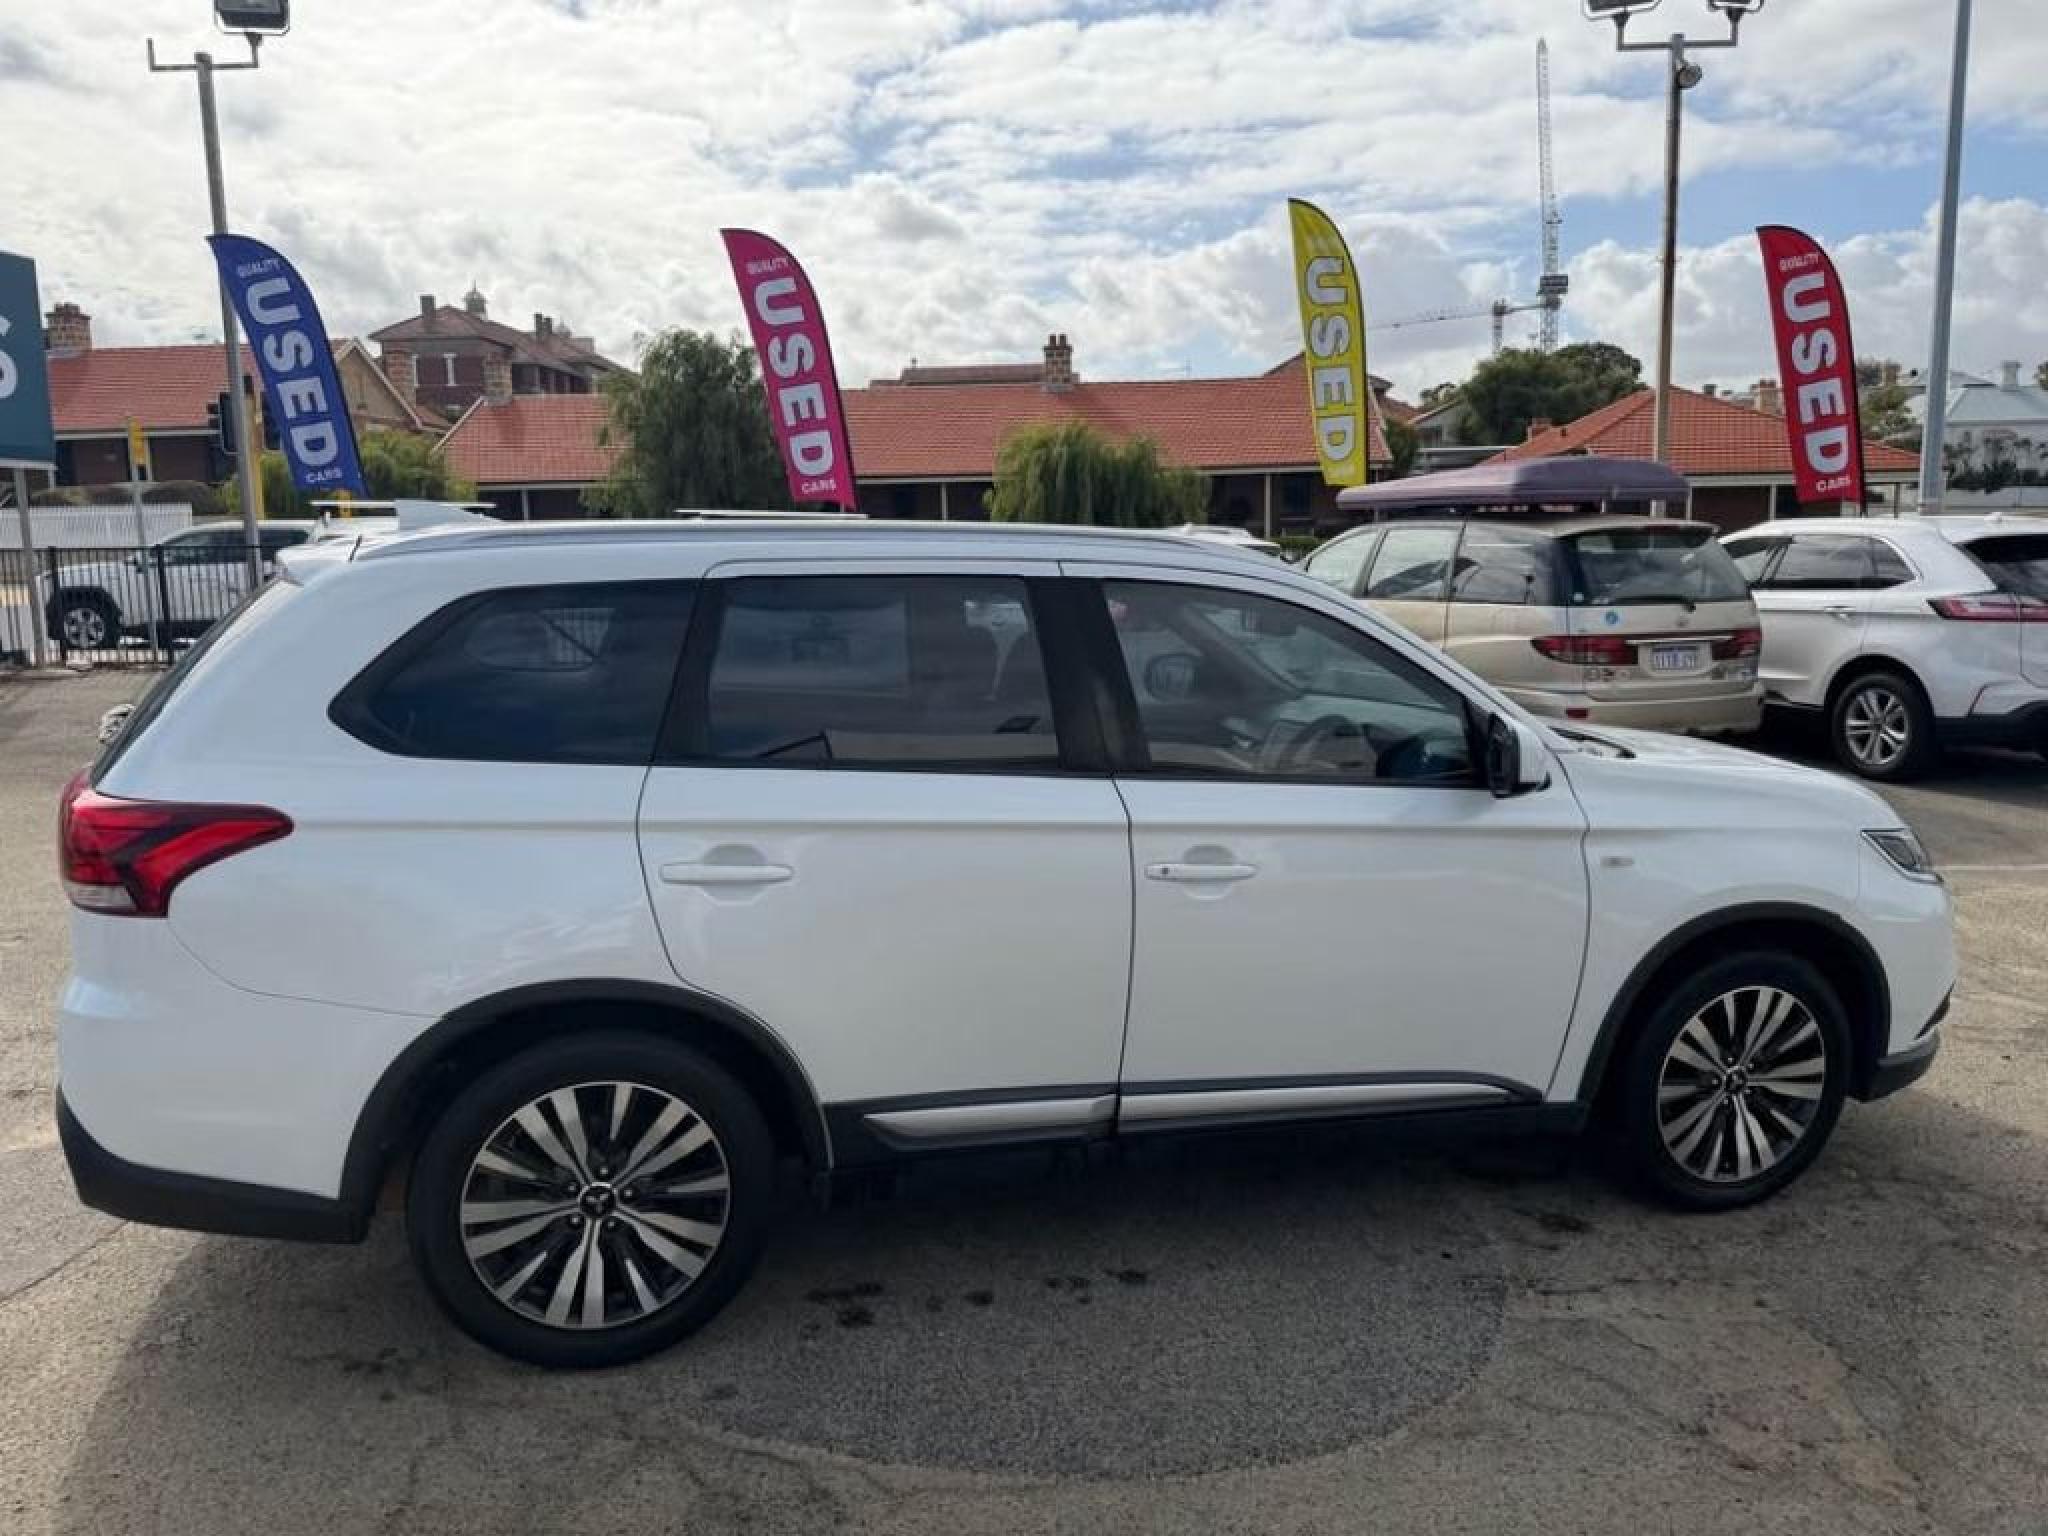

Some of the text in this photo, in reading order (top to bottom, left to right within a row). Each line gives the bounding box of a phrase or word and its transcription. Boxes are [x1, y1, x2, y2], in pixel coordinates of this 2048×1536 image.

[246, 276, 339, 466] USED
[753, 277, 834, 476] USED
[1306, 255, 1355, 460] USED
[1783, 271, 1849, 473] USED
